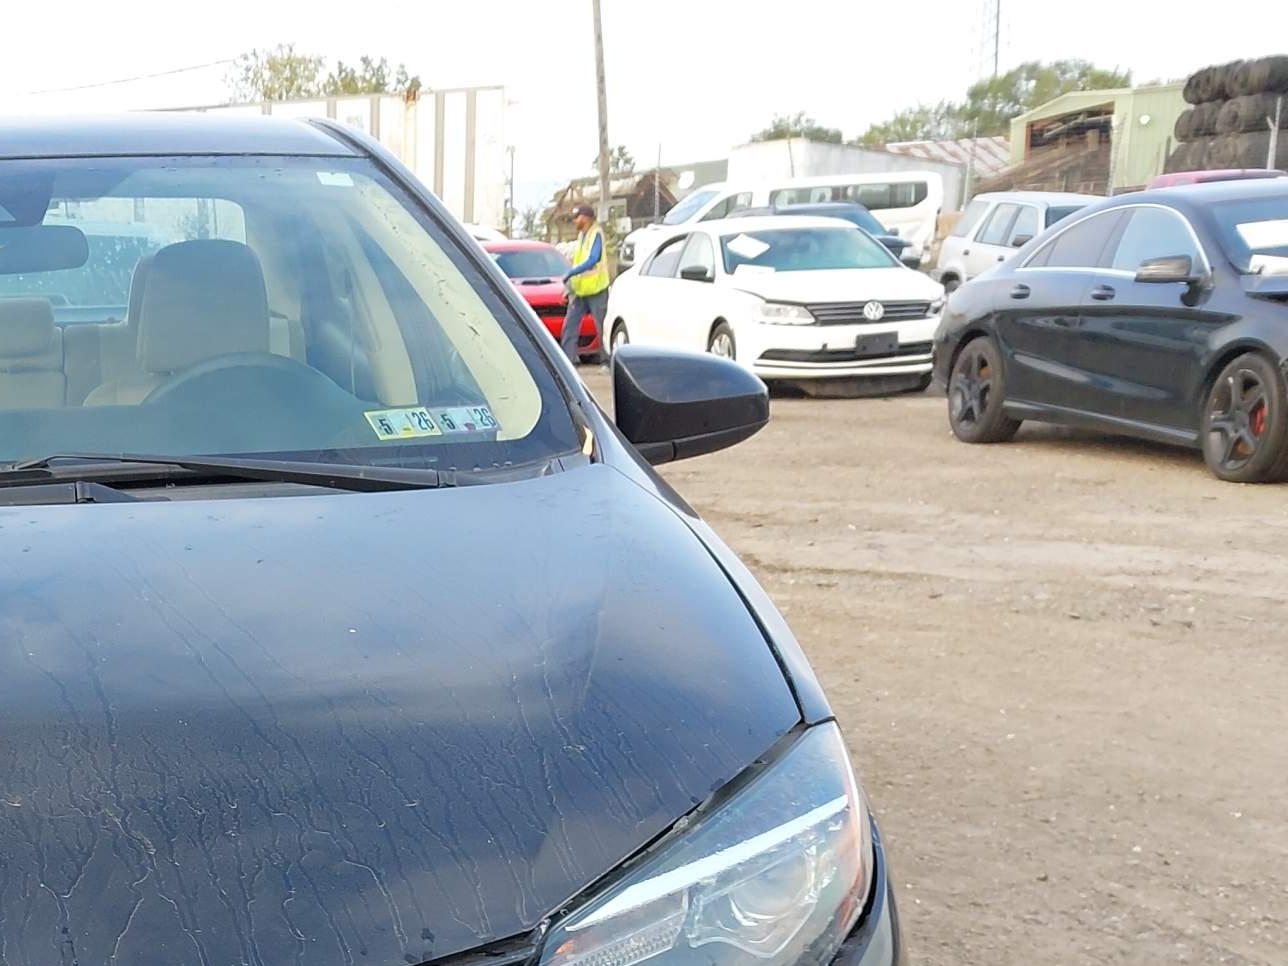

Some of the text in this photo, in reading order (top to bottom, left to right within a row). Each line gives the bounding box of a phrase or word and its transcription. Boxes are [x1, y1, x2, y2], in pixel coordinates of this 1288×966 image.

[379, 411, 435, 435] 5 26
[441, 408, 497, 430] 5 26
